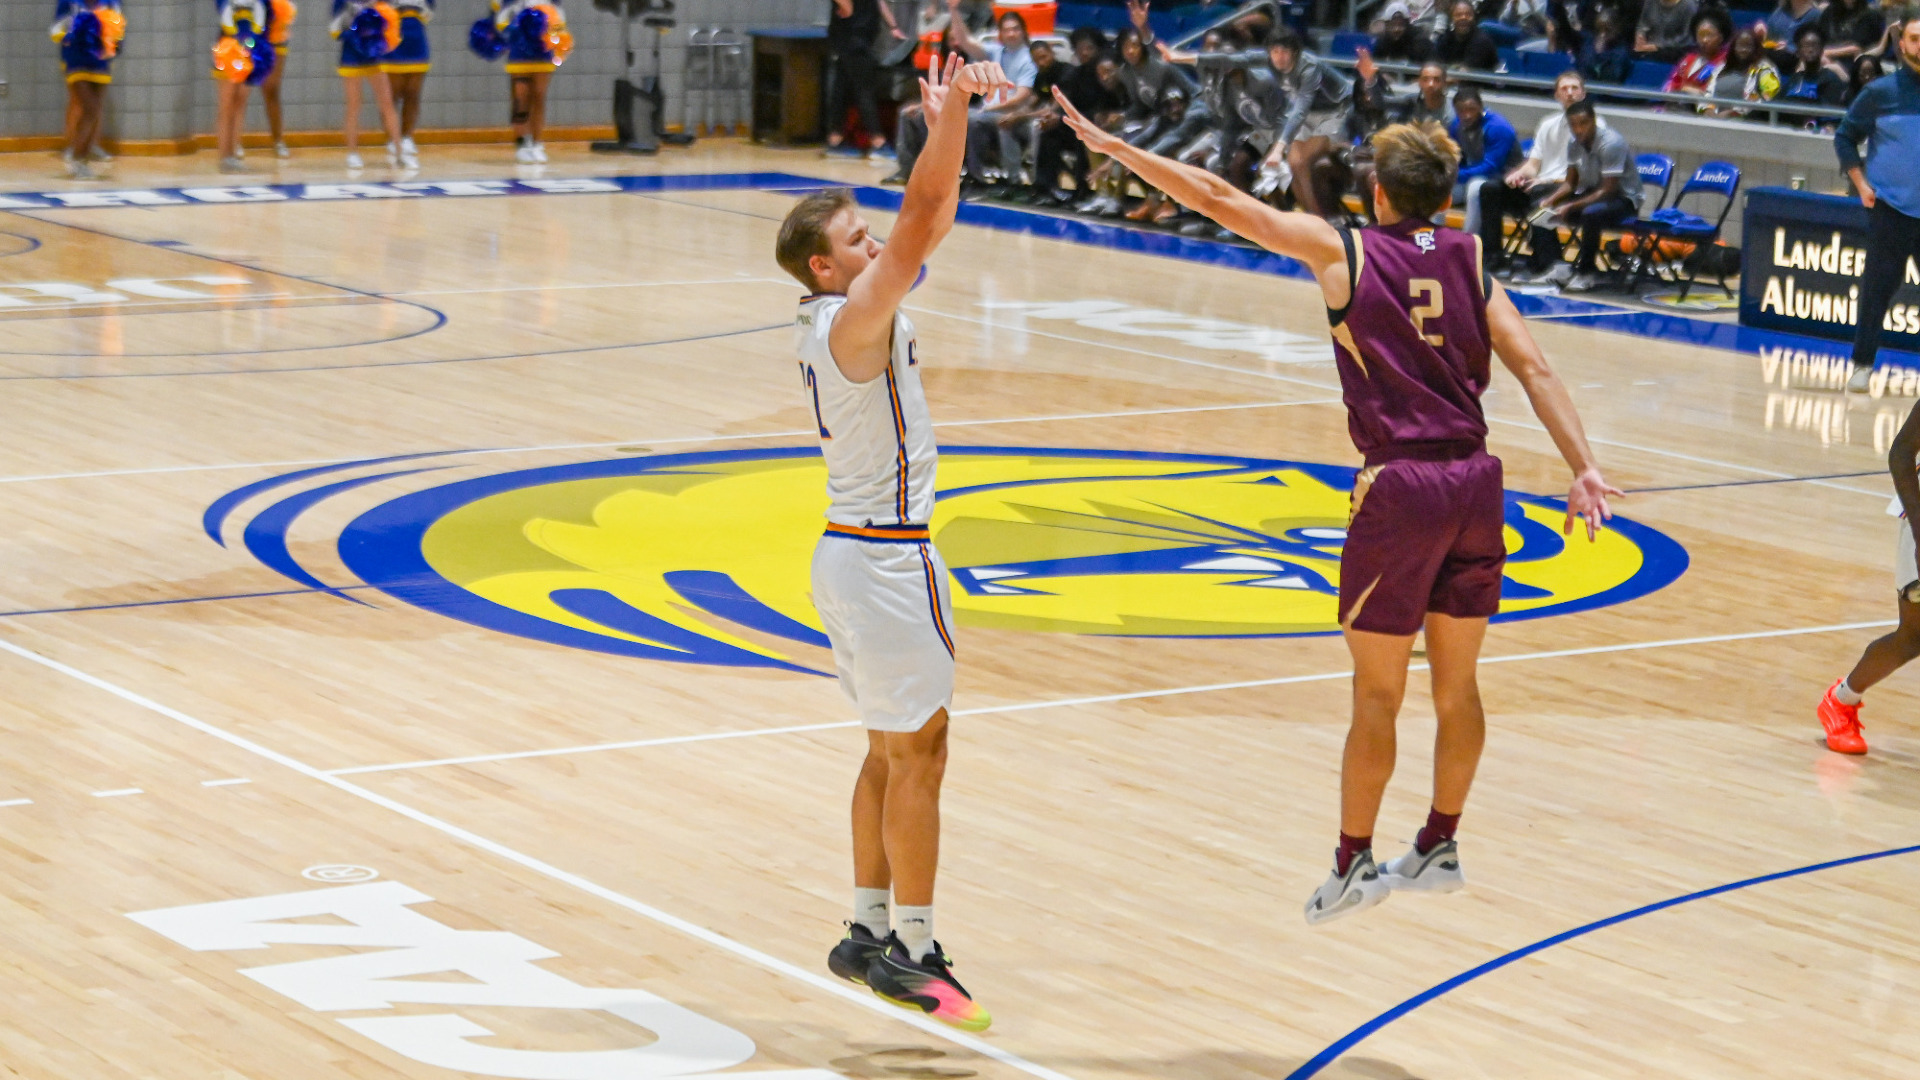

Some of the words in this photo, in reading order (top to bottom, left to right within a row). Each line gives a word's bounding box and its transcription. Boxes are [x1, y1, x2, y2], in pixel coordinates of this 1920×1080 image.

[1637, 164, 1664, 175] ander
[1694, 170, 1729, 183] Lander
[1408, 278, 1444, 347] 2
[122, 880, 850, 1080] CAA
